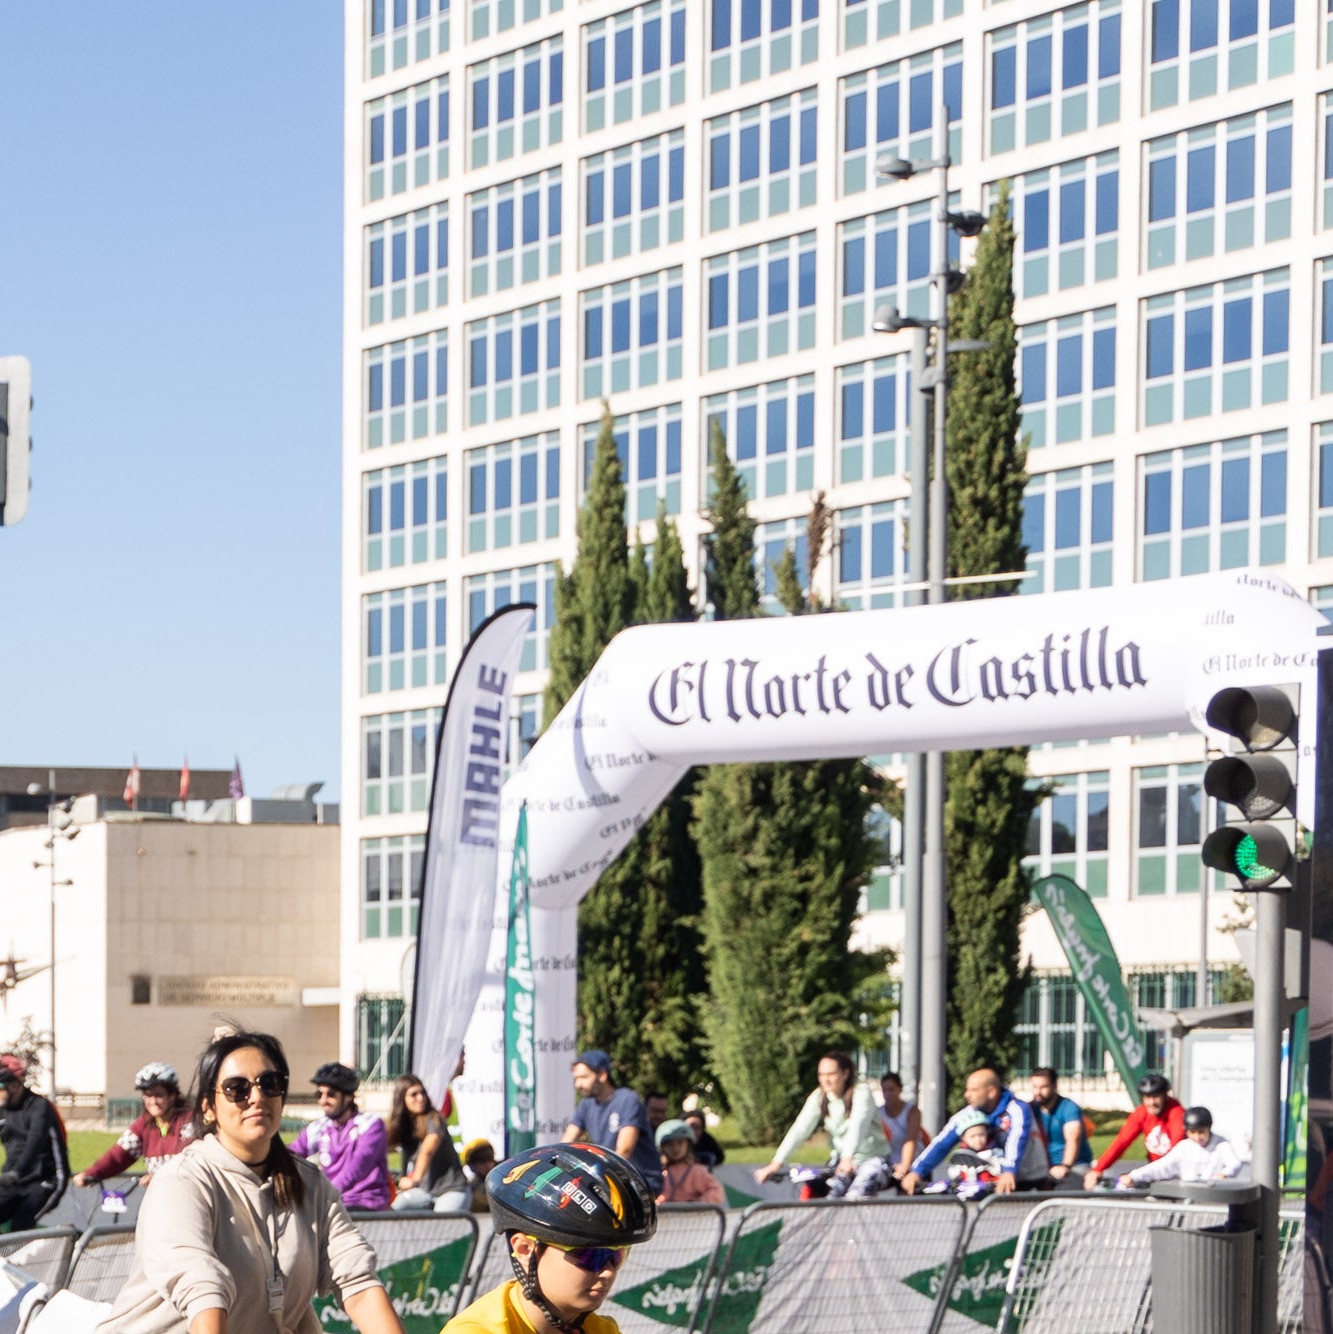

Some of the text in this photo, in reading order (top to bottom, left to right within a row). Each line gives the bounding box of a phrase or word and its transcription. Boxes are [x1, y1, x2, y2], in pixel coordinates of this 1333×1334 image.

[648, 626, 1148, 726] El Norte de Castilla
[1273, 652, 1287, 666] de
[460, 664, 508, 848] MAHLE
[512, 992, 534, 1088] Corte
